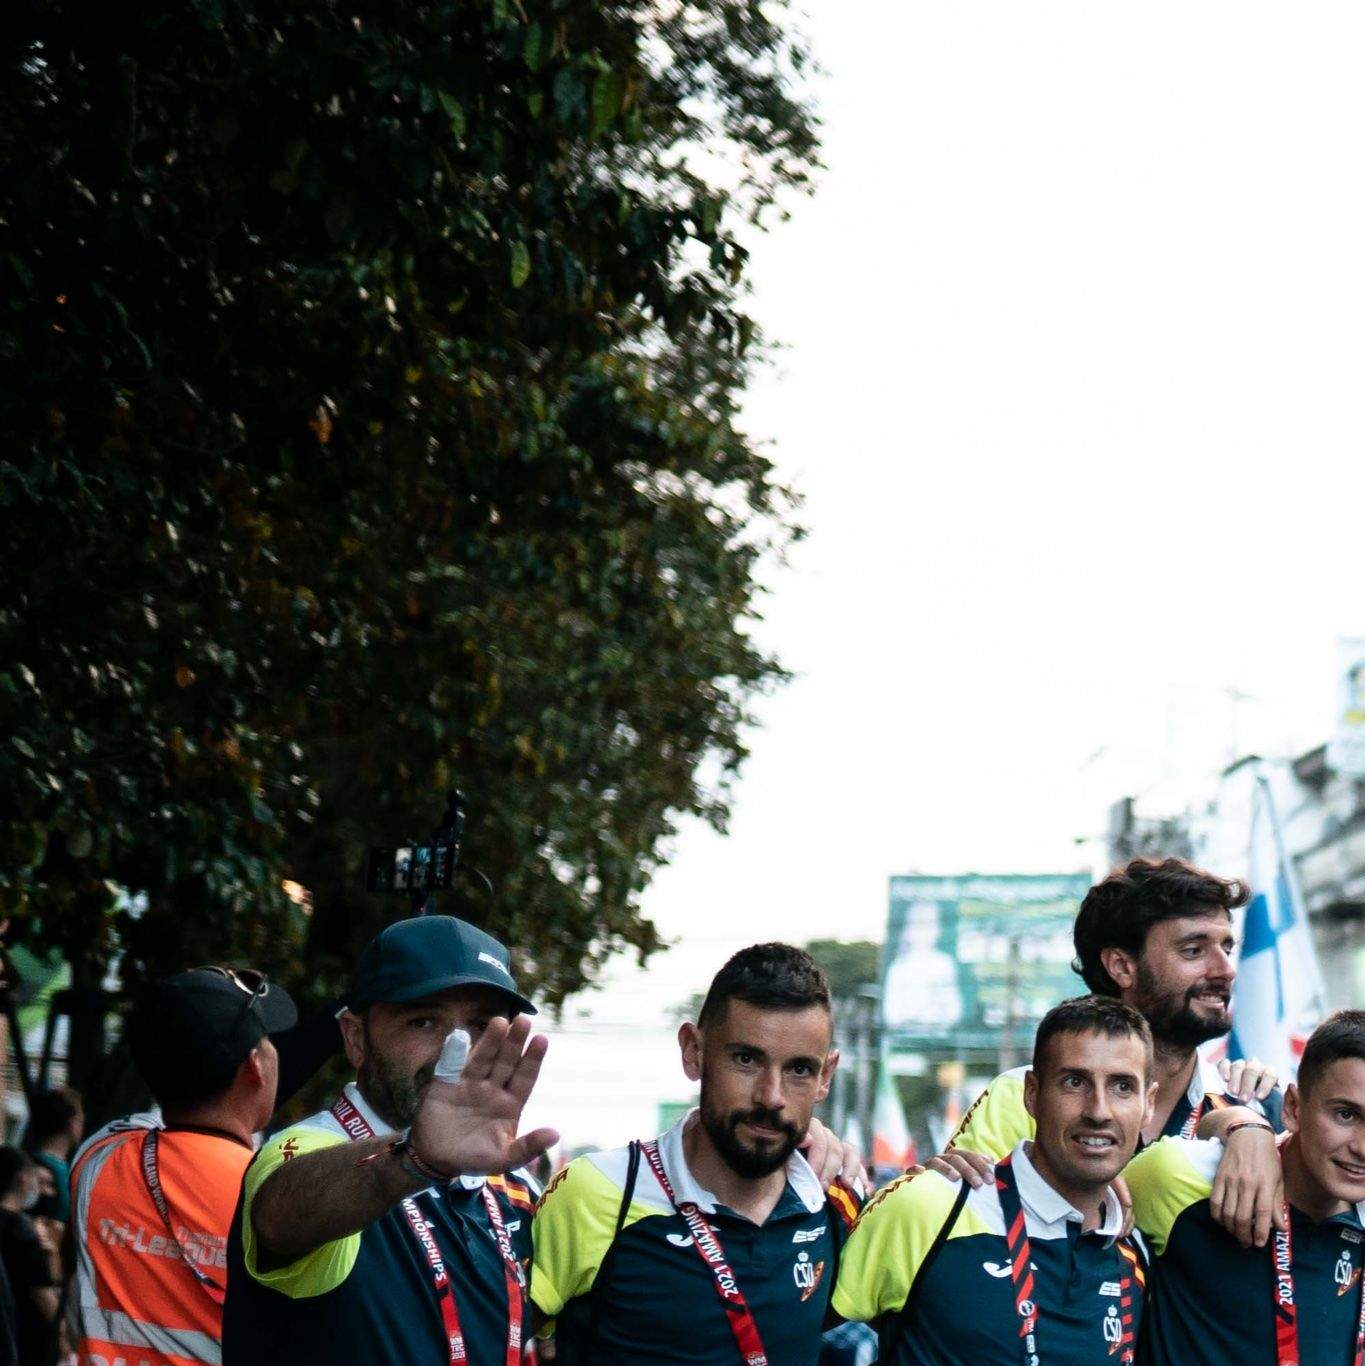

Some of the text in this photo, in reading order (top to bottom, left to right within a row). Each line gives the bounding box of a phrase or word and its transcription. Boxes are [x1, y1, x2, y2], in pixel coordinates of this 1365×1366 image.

[402, 1199, 447, 1282] MPIONSHIPS
[681, 1204, 739, 1298] 2021 AMAZING
[1276, 1231, 1294, 1305] 2021 AMAZI
[1099, 1281, 1121, 1297] ES
[1103, 1316, 1122, 1342] CSD
